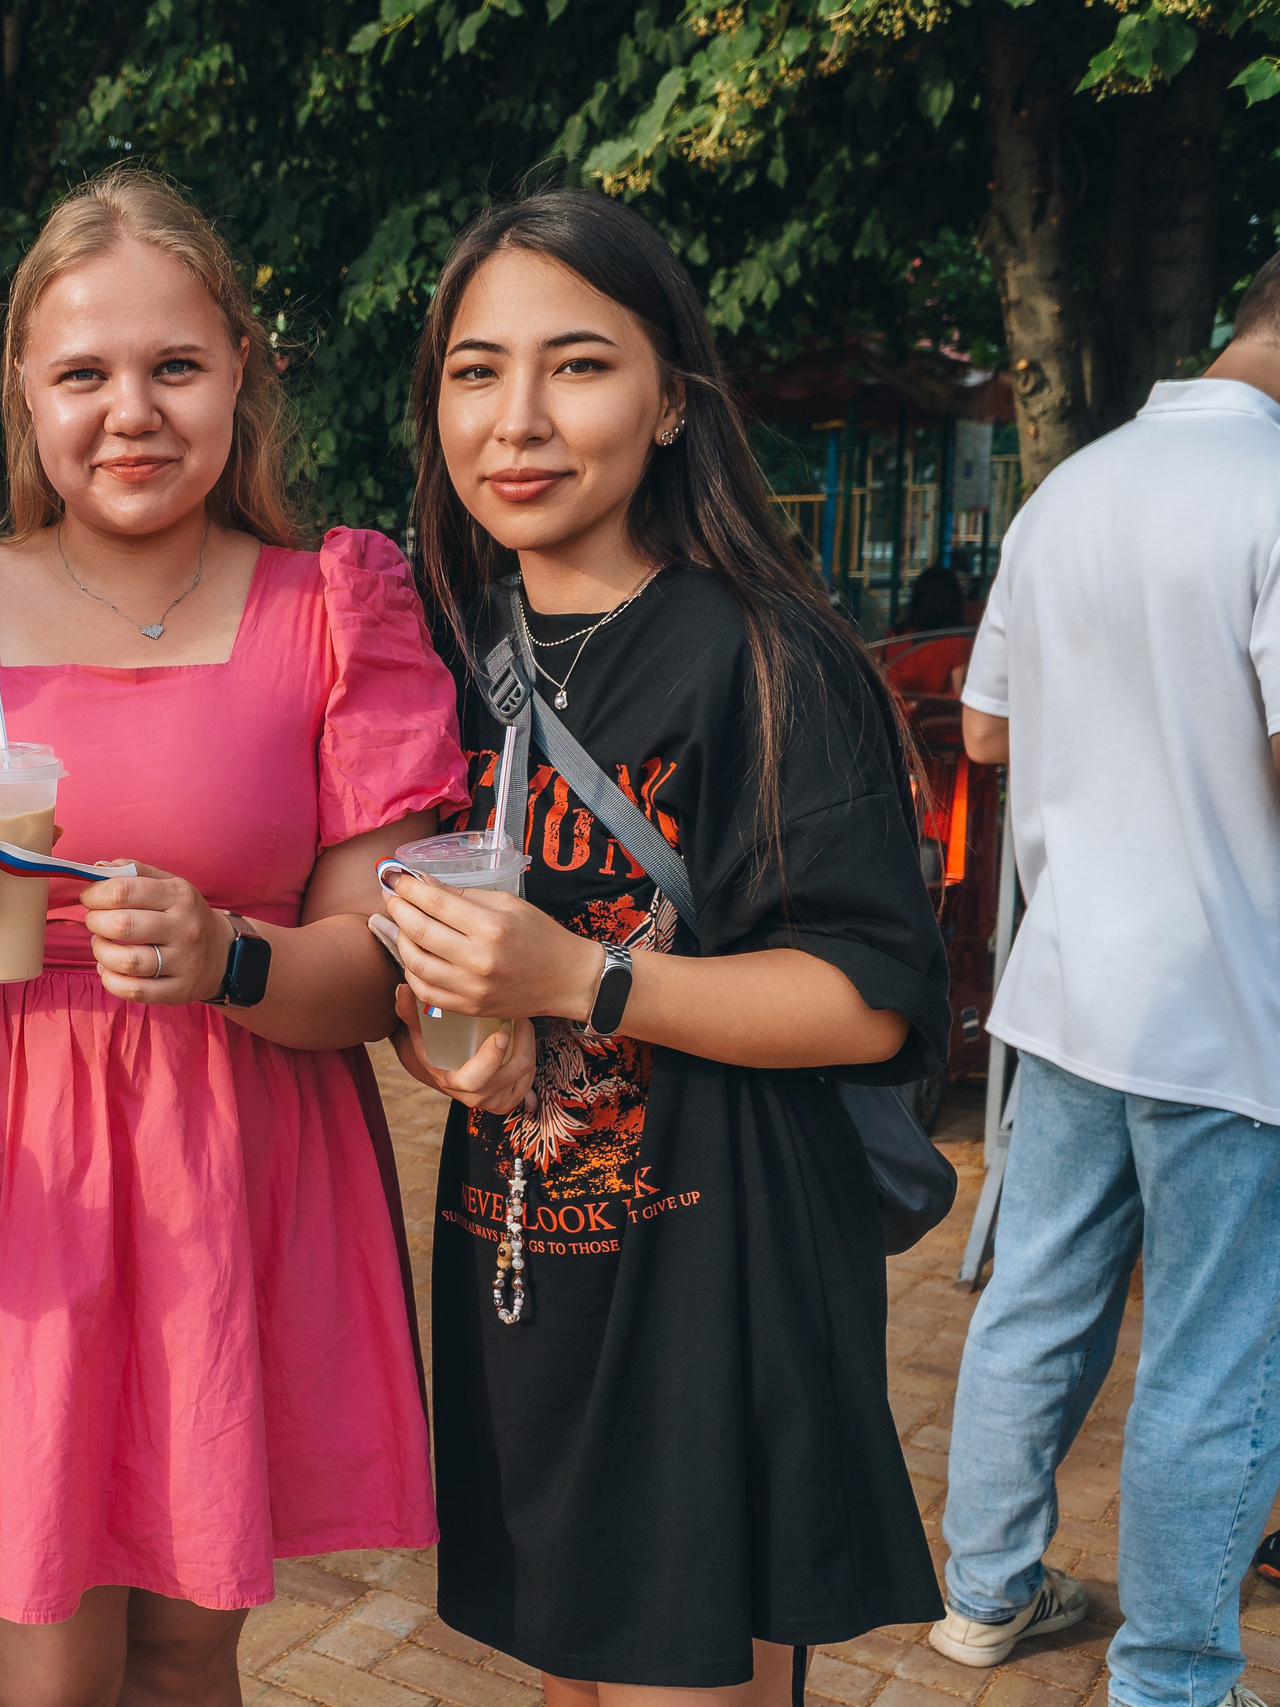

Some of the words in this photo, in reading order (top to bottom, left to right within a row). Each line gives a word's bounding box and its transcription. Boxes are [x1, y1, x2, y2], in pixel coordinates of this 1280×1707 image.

[462, 1182, 510, 1223] NEVE
[521, 1202, 617, 1233] LOOK
[468, 1222, 498, 1242] ALWAYS
[547, 1242, 567, 1255] TO
[568, 1239, 620, 1255] THOSE
[642, 1196, 677, 1219] GIVE
[679, 1191, 700, 1206] UP
